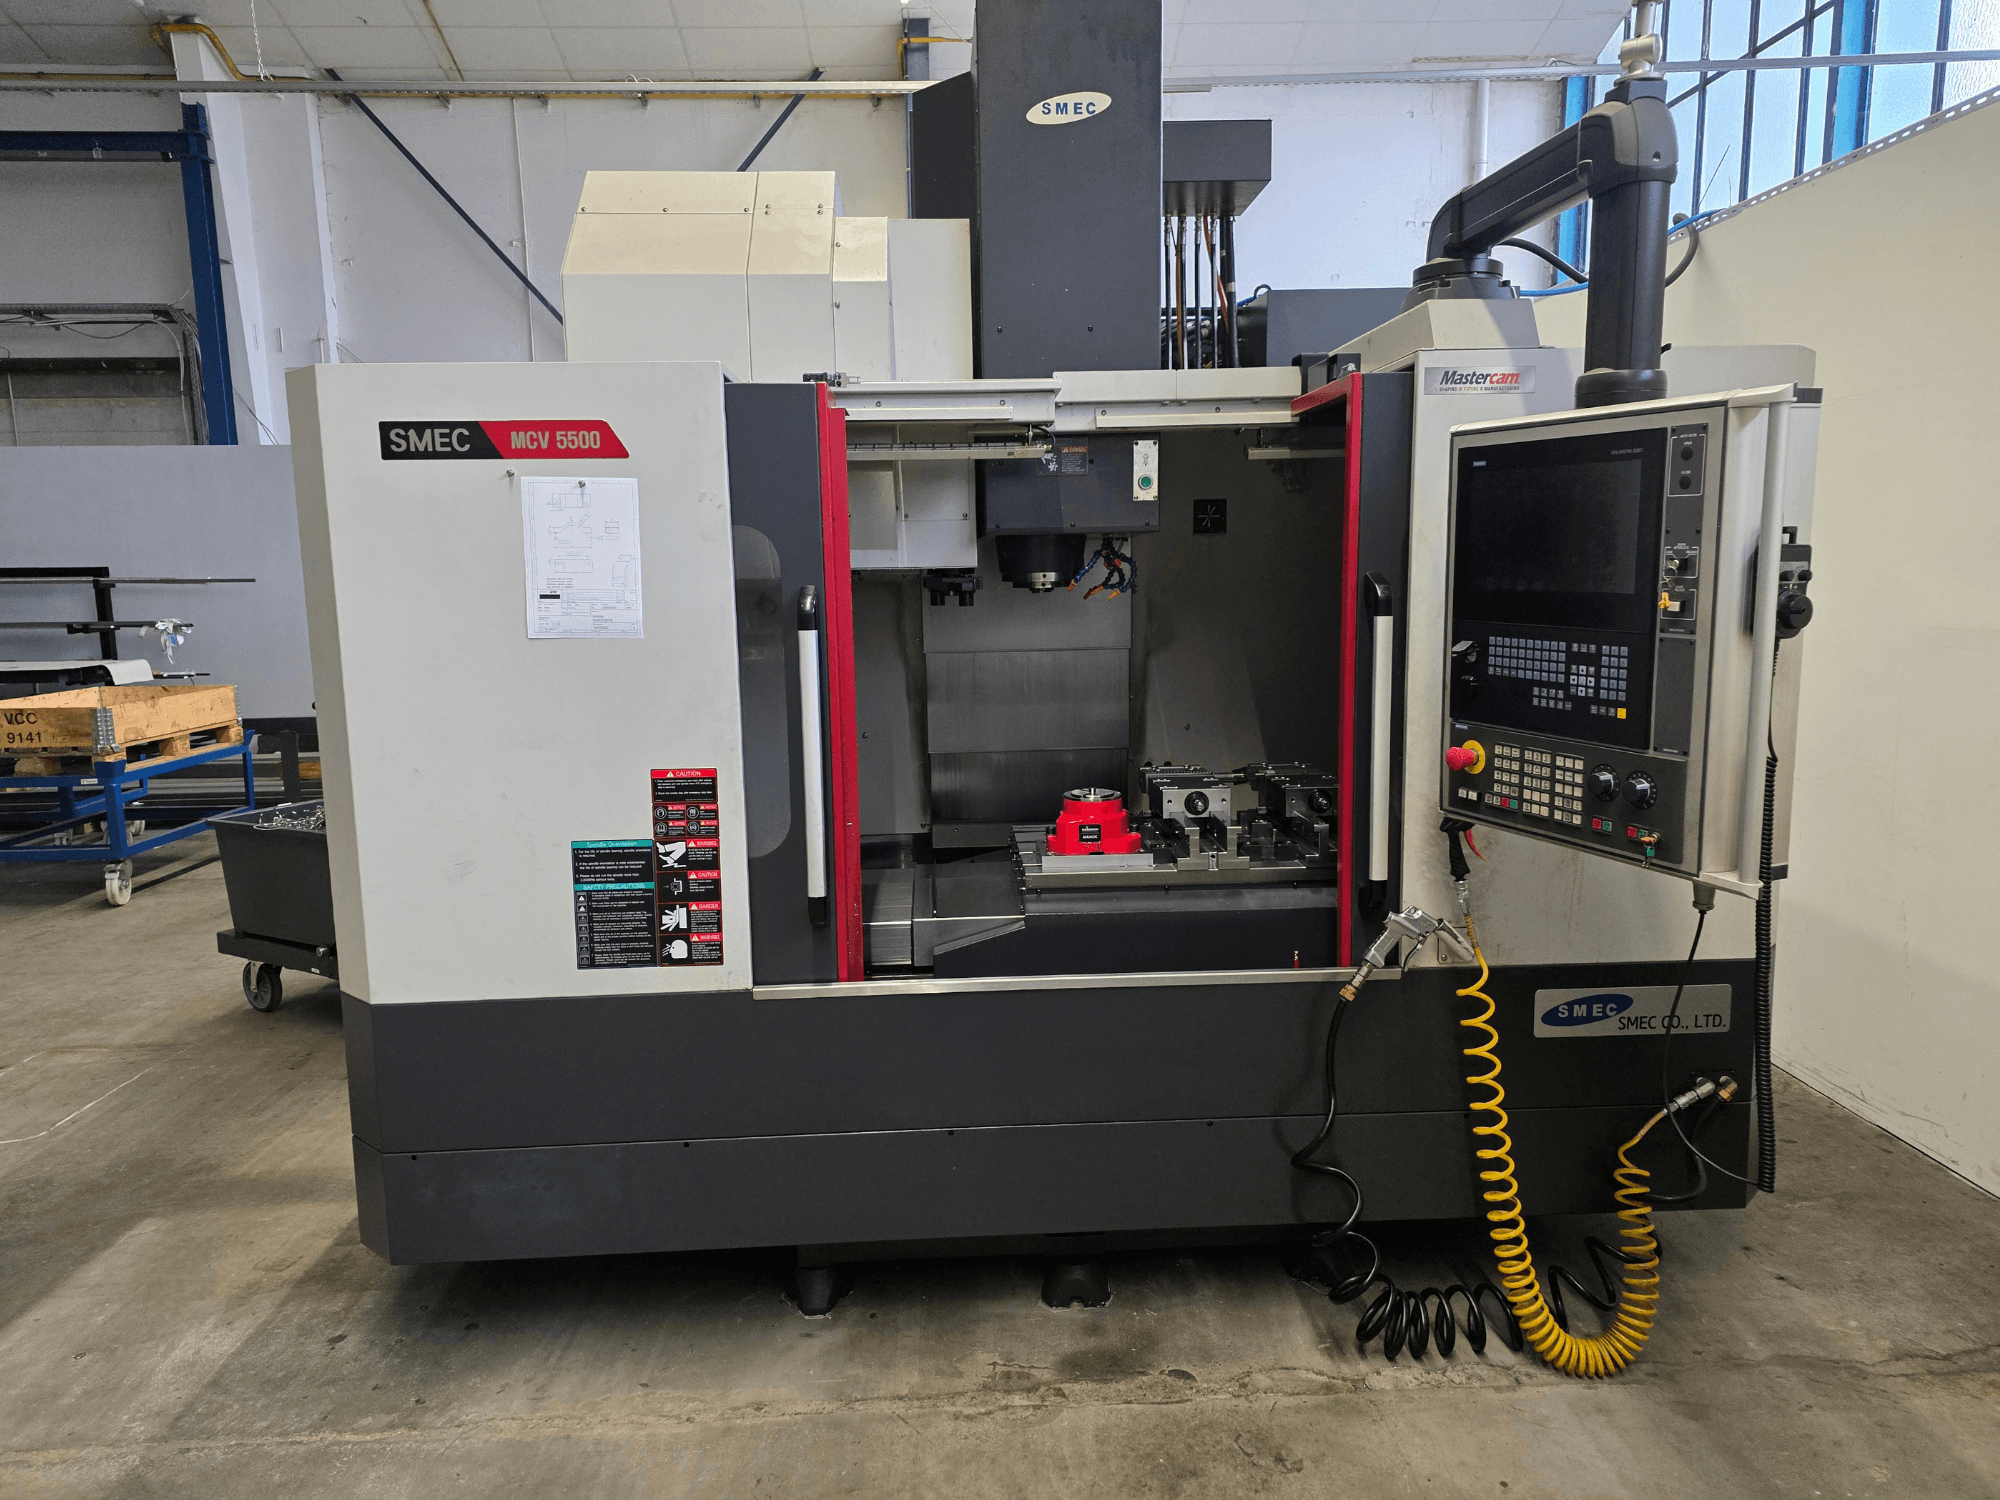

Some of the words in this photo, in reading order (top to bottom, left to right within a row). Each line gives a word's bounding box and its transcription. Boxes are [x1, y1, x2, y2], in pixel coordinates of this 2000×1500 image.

[1042, 102, 1096, 115] SMEC
[1440, 370, 1520, 385] Mastercam
[389, 428, 470, 452] SMEC
[511, 431, 549, 450] MCV
[556, 430, 600, 449] 5500
[4, 712, 38, 725] VCC
[6, 732, 42, 744] 9141
[1558, 1003, 1618, 1018] SMEC
[1618, 1016, 1656, 1030] SMEC
[1661, 1014, 1688, 1030] CO.,
[1694, 1014, 1726, 1028] LTD.
